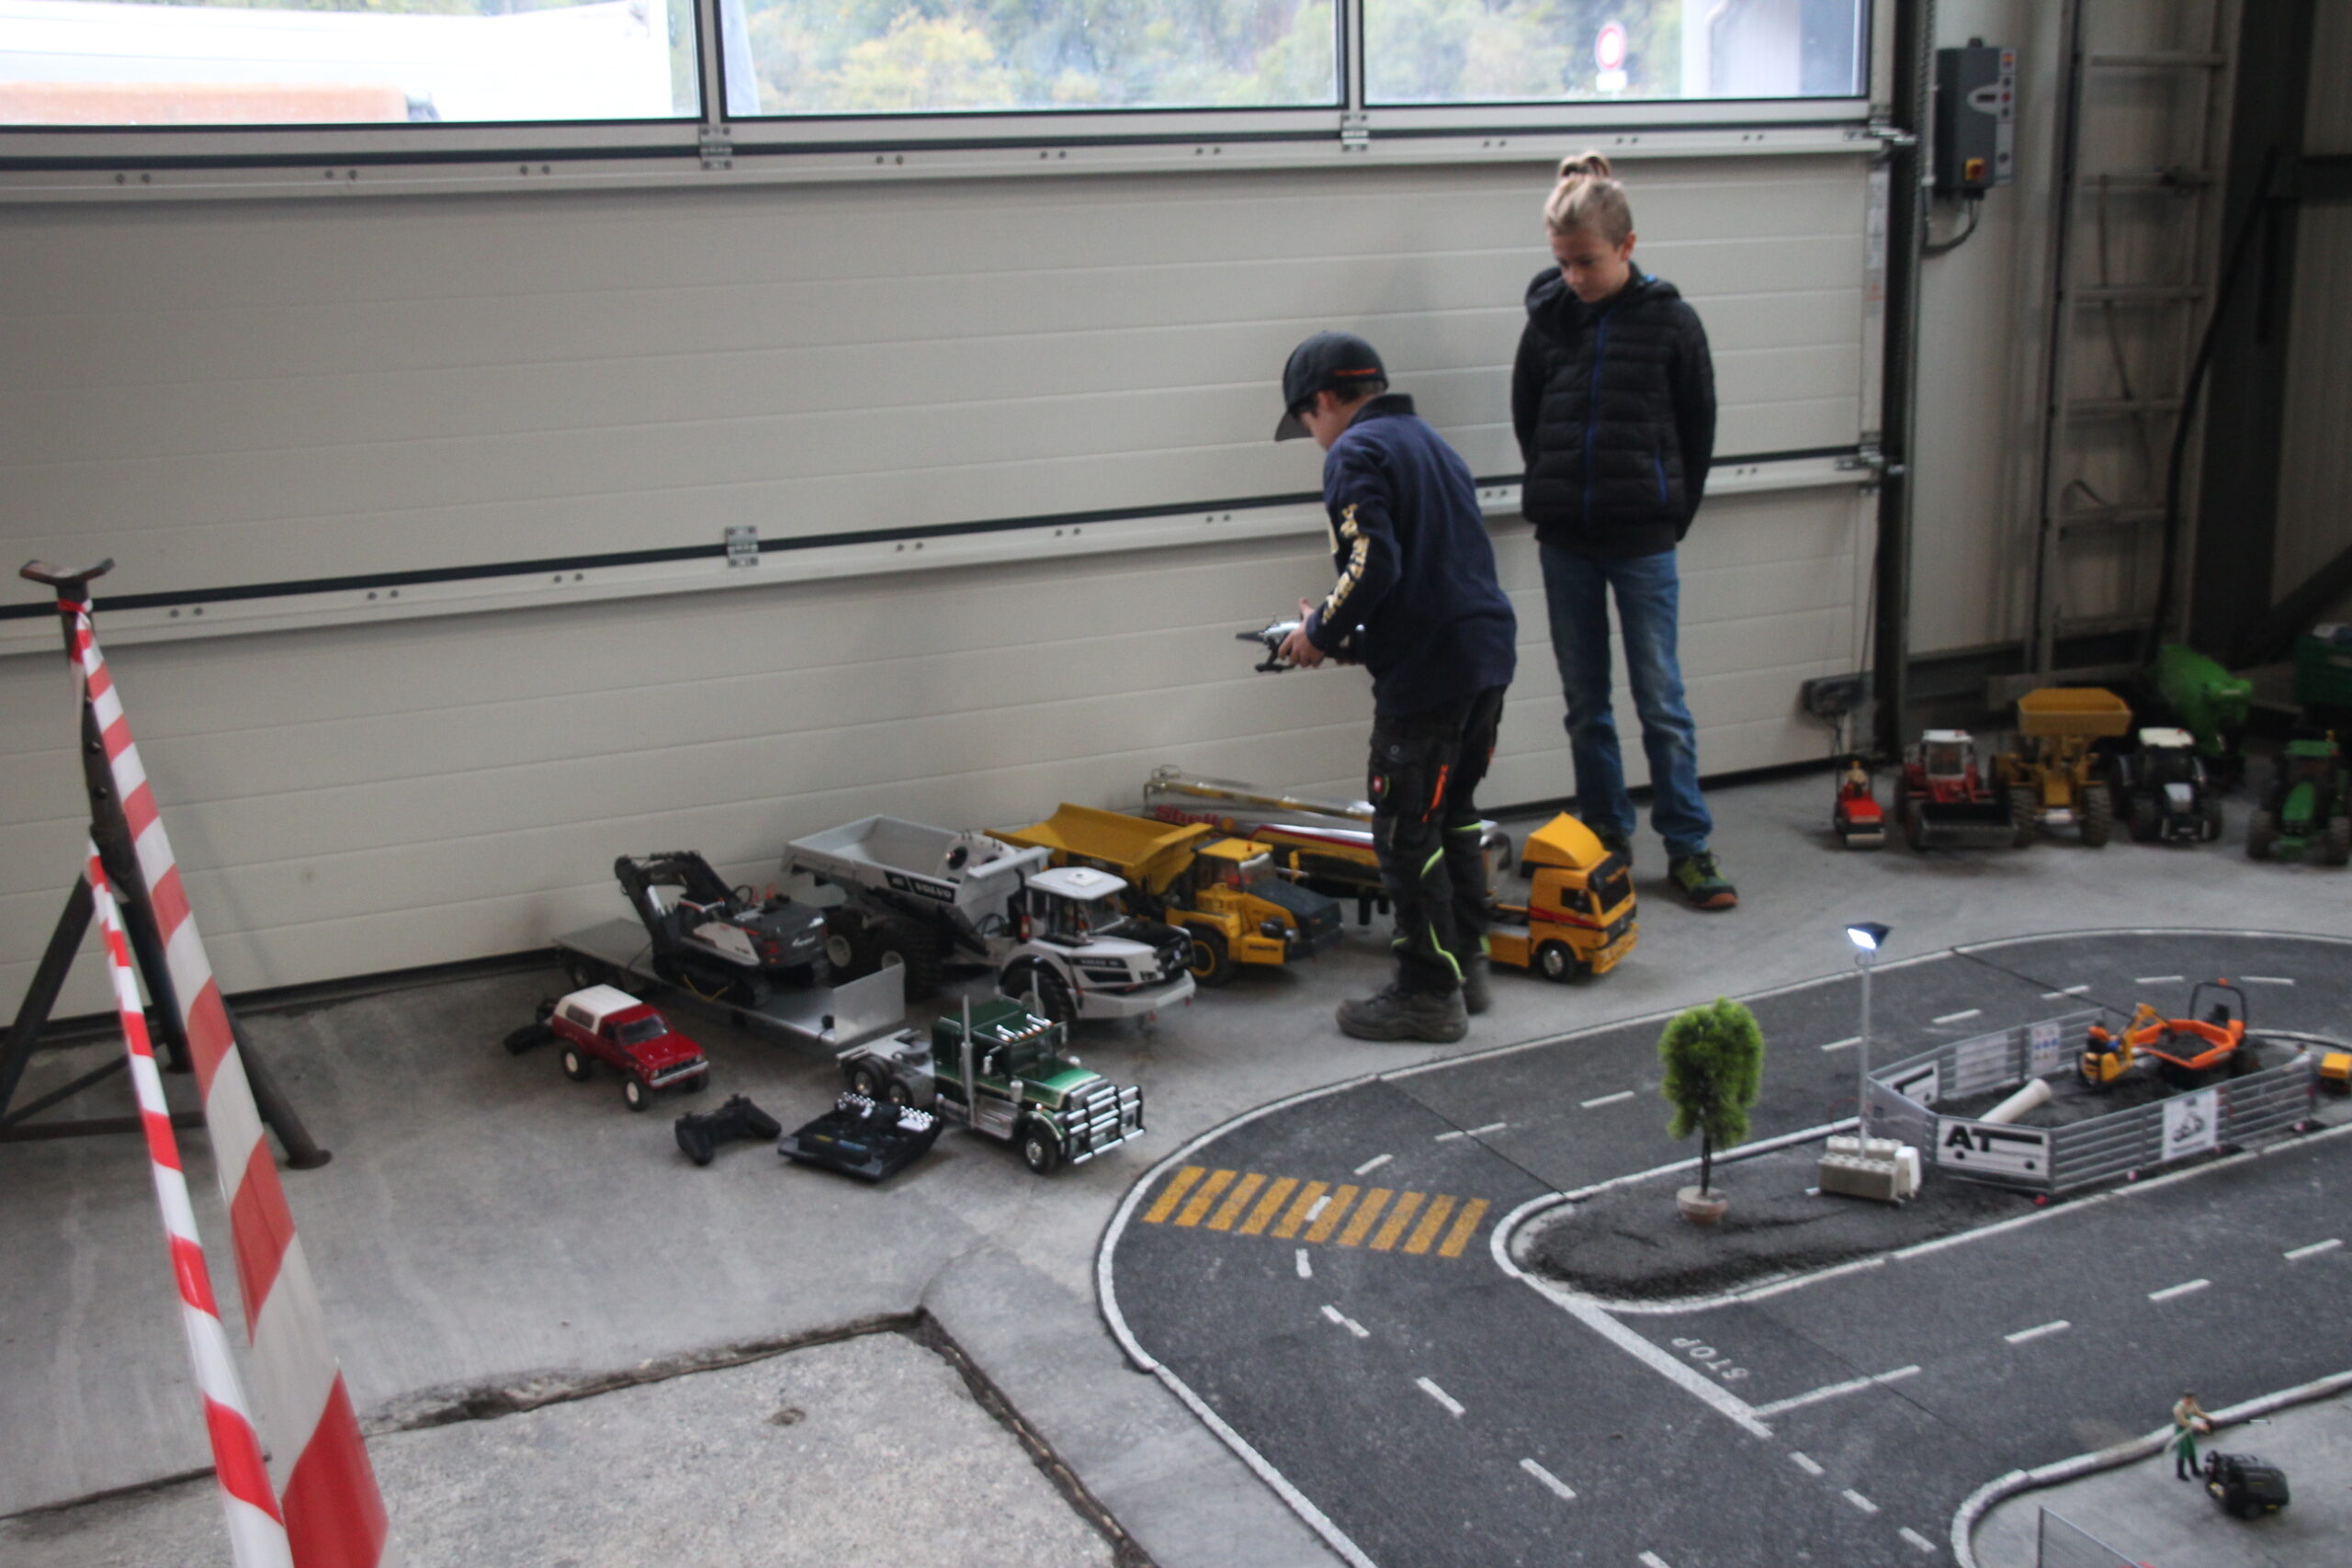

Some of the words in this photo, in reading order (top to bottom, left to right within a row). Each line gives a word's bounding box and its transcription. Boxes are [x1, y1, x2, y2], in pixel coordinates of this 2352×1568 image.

[1154, 805, 1219, 826] Shell
[914, 881, 952, 898] VOLVO
[1671, 1337, 1749, 1380] STOP
